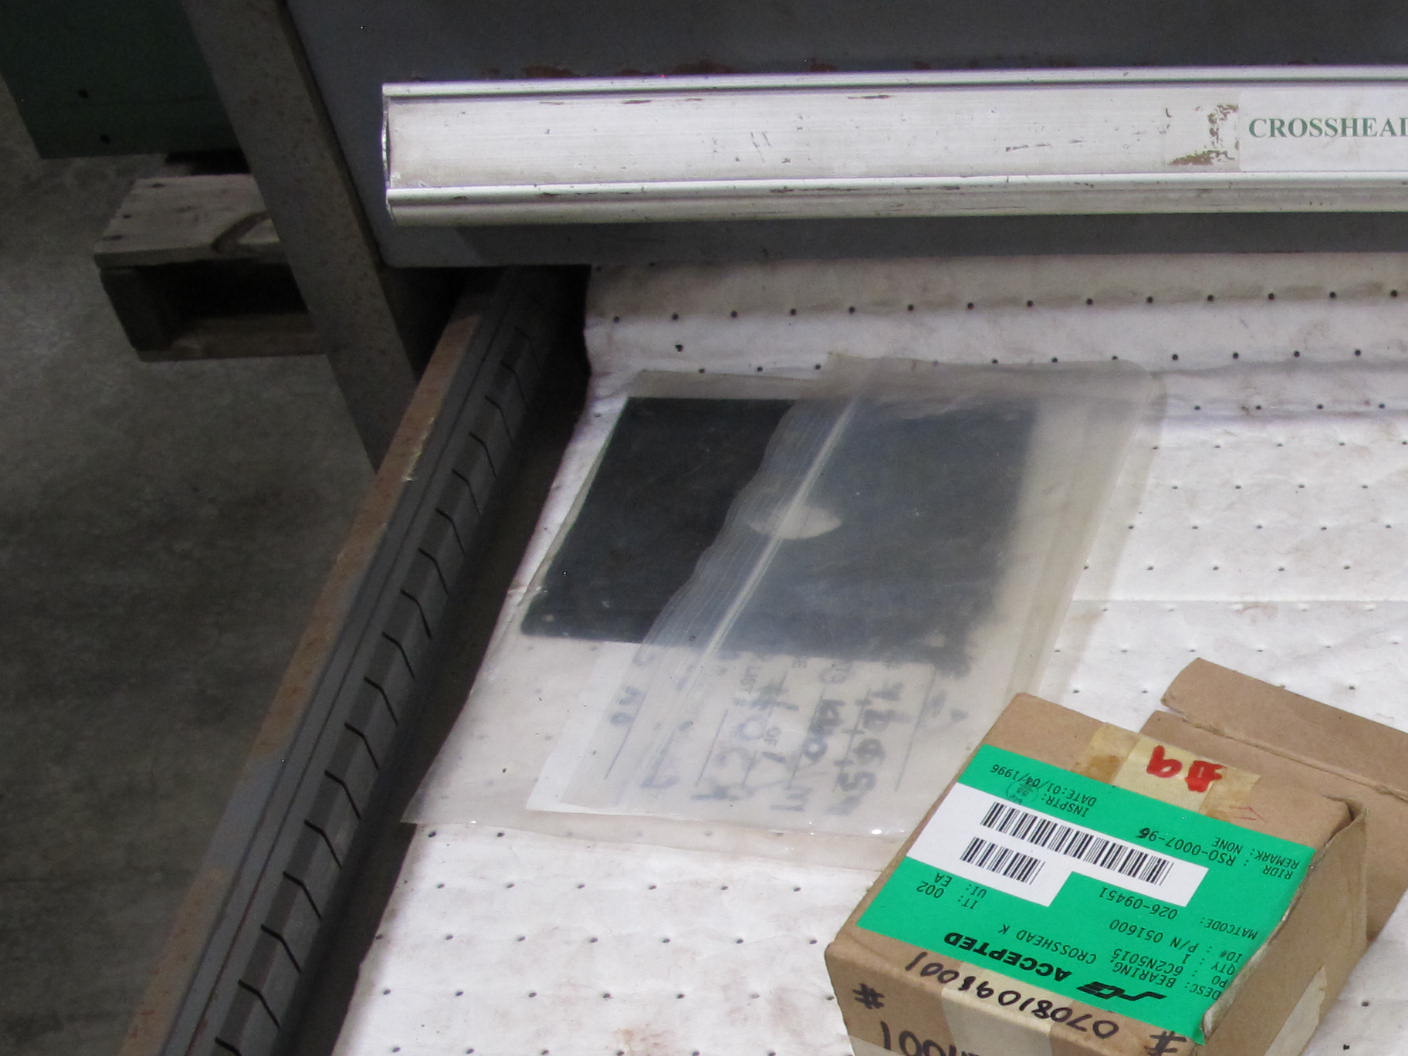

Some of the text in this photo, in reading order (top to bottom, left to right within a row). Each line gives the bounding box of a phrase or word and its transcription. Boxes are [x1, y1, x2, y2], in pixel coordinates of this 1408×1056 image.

[1037, 793, 1090, 817] INSPTR:
[1210, 836, 1300, 871] REMARK: NONE
[931, 871, 953, 886] EA
[1260, 863, 1294, 881] RIDR
[914, 879, 979, 909] IT: 002
[1097, 885, 1258, 941] MATCODE: 026-09451
[997, 923, 1011, 934] K
[1107, 916, 1165, 944] 051600
[941, 929, 1072, 984] ACCEPTED
[1013, 928, 1098, 965] CROSSHEAD
[1168, 935, 1199, 953] P/N
[1109, 944, 1229, 988] PO 6C2N5015
[1210, 958, 1238, 975] QTY
[1181, 979, 1222, 1001] DESC:
